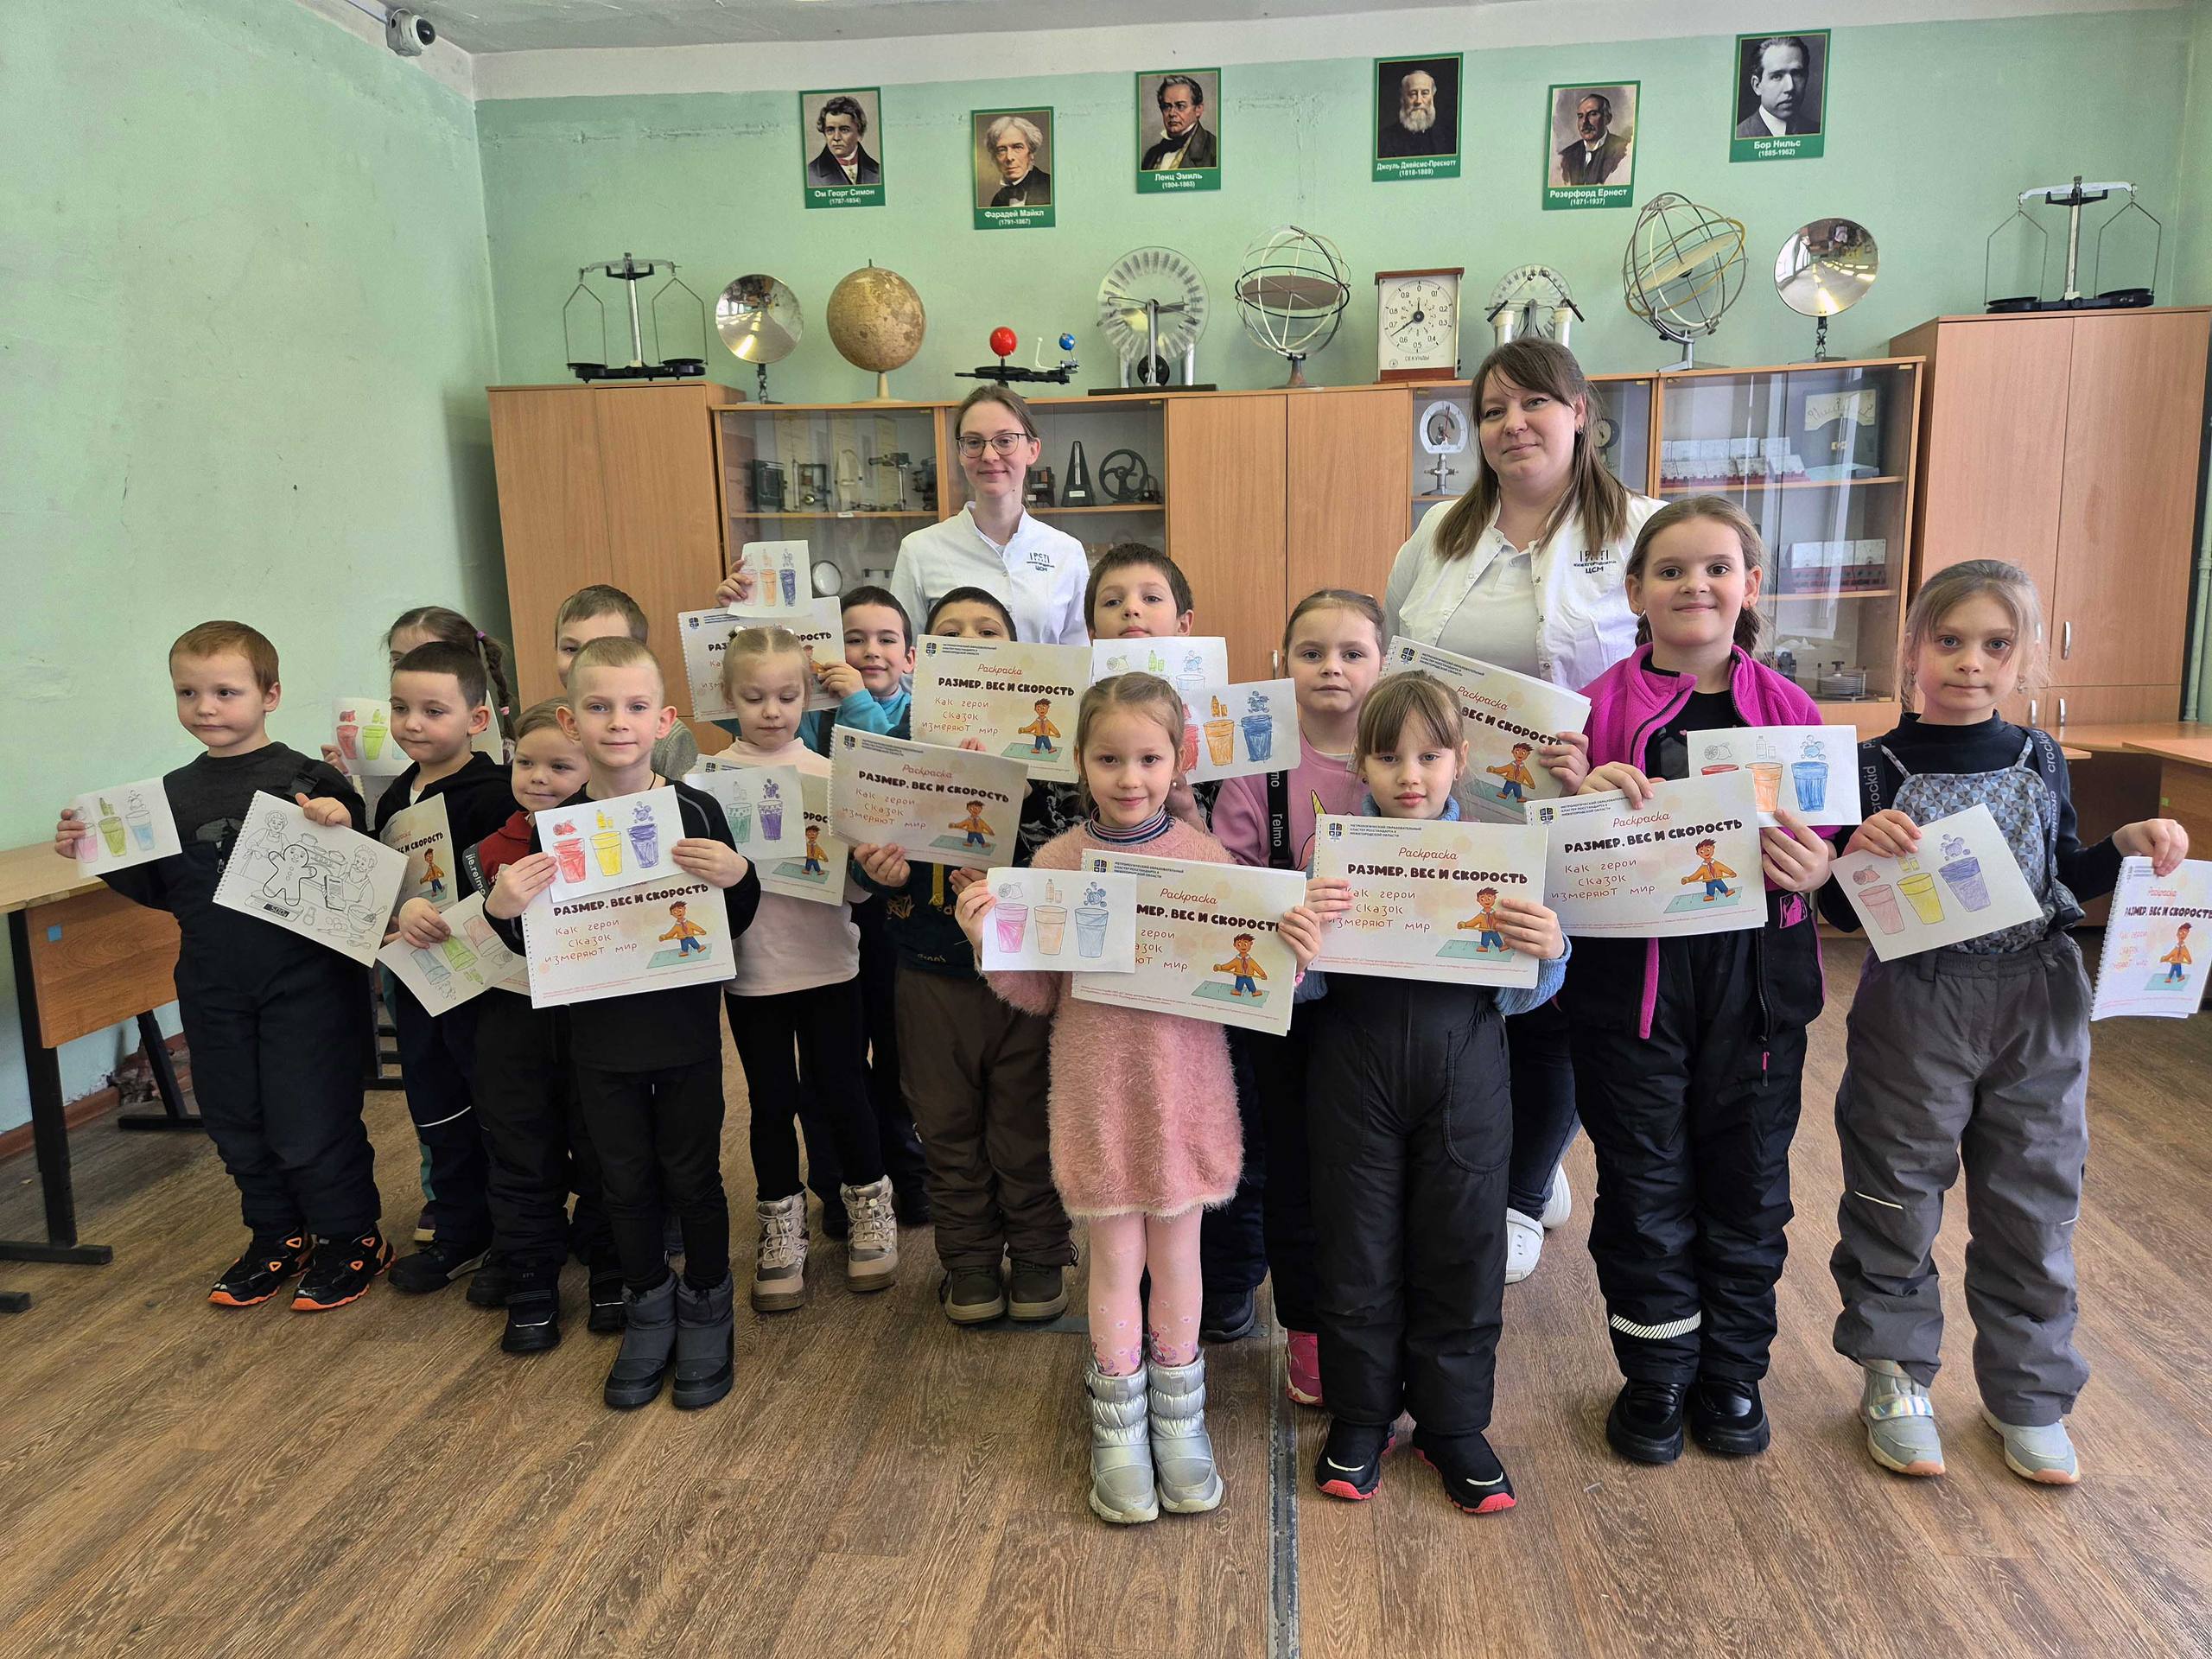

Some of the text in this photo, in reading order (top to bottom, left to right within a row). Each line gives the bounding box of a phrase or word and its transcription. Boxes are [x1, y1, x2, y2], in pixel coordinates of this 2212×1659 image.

[1754, 141, 1771, 149] Бор
[828, 189, 849, 198] Георг
[1549, 188, 1628, 199] Резерфорд Ернест
[984, 210, 1018, 219] Фарадей
[977, 663, 1023, 676] Раскраска
[938, 677, 1075, 696] РАЗМЕР. ВЕС И СКОРОСТЬ
[935, 697, 988, 709] Как герои
[1457, 685, 1510, 712] Раскраска
[1461, 706, 1484, 721] ВЕС
[1484, 715, 1496, 726] И
[922, 721, 998, 737] измеряют мир
[902, 764, 953, 778] Раскраска
[859, 771, 909, 789] РАЗМЕР.
[912, 781, 933, 791] ВЕС
[947, 785, 1009, 803] СКОРОСТЬ
[1862, 766, 1882, 814] crockid
[855, 788, 915, 805] Как герои
[842, 806, 895, 825] измеряют
[1612, 811, 1671, 828] Раскраска
[410, 831, 444, 849] СКОРОСТЬ
[1564, 819, 1742, 854] РАЗМЕР. ВЕС И СКОРОСТЬ
[1398, 847, 1458, 861] Раскраска
[1348, 864, 1528, 884] РАЗМЕР. ВЕС И СКОРОСТЬ
[1565, 859, 1637, 874] Как герои
[554, 900, 609, 917] РАЗМЕР.
[611, 895, 632, 907] ВЕС
[634, 893, 644, 904] И
[645, 883, 709, 902] СКОРОСТЬ
[1160, 887, 1217, 906] Раскраска
[1380, 890, 1415, 901] герои
[1551, 885, 1656, 902] измеряют мир
[1136, 904, 1168, 918] МЕР.
[1171, 909, 1195, 922] ВЕС
[1198, 912, 1209, 923] И
[2149, 906, 2161, 916] ВЕС
[556, 919, 620, 936] Как герои
[1141, 928, 1175, 939] герои
[1405, 922, 1431, 932] мир
[545, 943, 638, 964] измеряют мир
[1163, 961, 1188, 972] мир
